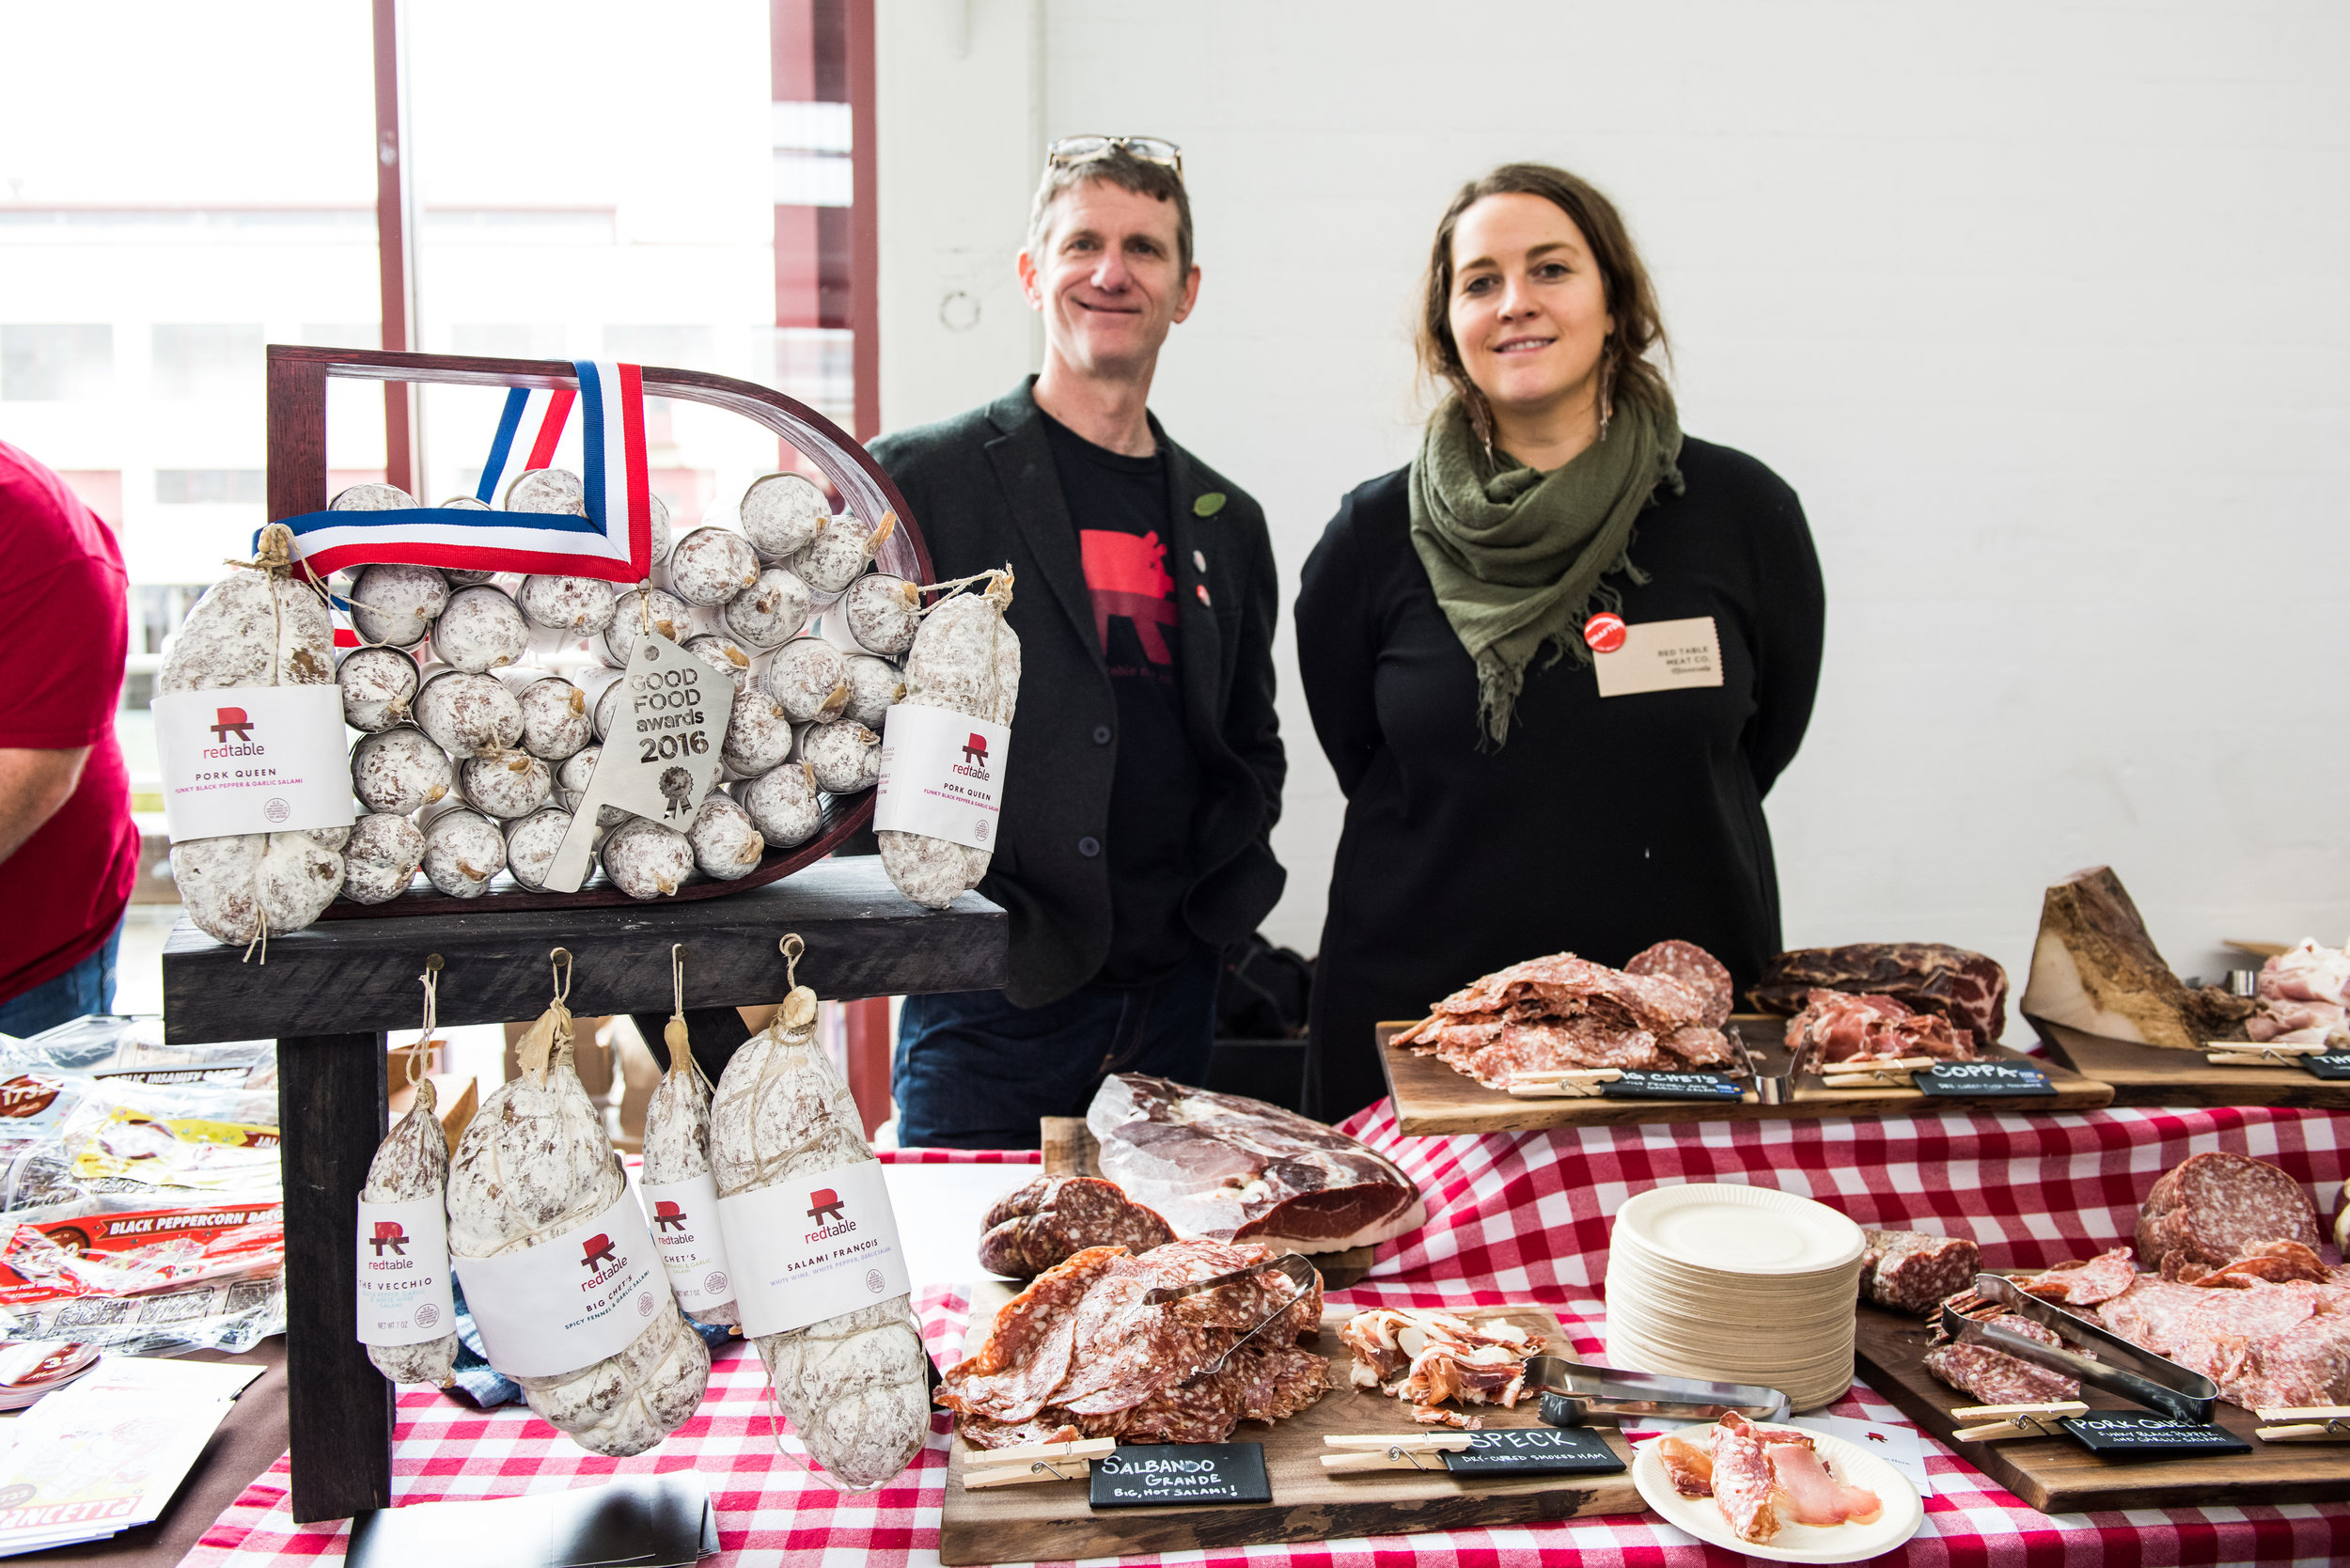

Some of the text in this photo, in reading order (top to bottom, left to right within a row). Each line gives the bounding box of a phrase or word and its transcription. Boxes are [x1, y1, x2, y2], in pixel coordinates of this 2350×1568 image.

[1658, 647, 1708, 657] RED TABLE
[630, 667, 698, 692] GOOD
[633, 688, 701, 714] FOOD
[636, 709, 705, 733] awards
[203, 743, 265, 760] redtable
[639, 730, 710, 764] 2016
[196, 768, 277, 781] PORK QUEEN
[952, 763, 990, 781] redtable
[252, 779, 276, 788] GARLIC
[277, 777, 304, 786] SALAMI
[923, 789, 941, 797] FUNKY
[941, 792, 955, 801] BLACK
[955, 796, 971, 805] PEPPER
[975, 801, 988, 809] GARLIC
[944, 782, 992, 801] PORK QUEEN
[1622, 1072, 1645, 1081] IG
[1931, 1064, 2018, 1078] COPPA
[110, 1207, 284, 1236] BLACK PEPPERCORN BACO
[658, 1233, 695, 1246] redtable
[805, 1220, 857, 1245] redtable
[664, 1254, 697, 1263] CHET'S
[787, 1238, 879, 1272] SALAMI FRANÇOIS
[368, 1259, 414, 1270] redtable
[770, 1277, 790, 1287] WHITE
[812, 1264, 834, 1276] WHITE
[860, 1251, 878, 1261] GARLIC
[581, 1256, 629, 1293] redtable
[359, 1278, 432, 1291] THE VECCHIO
[565, 1320, 585, 1330] SPICY
[587, 1308, 612, 1322] FENNEL
[616, 1286, 633, 1304] GARLIC
[633, 1270, 650, 1288] SALAMI
[587, 1275, 633, 1313] BIG CHET'S
[2069, 1419, 2139, 1431] PORK
[1470, 1432, 1577, 1449] SPECK
[1101, 1455, 1215, 1475] SALBANDO
[1462, 1454, 1528, 1464] DRY-CURED
[1576, 1452, 1607, 1461] HAM
[1145, 1473, 1222, 1487] GRANDE
[1114, 1488, 1142, 1499] BIG,
[1144, 1488, 1169, 1497] HOT
